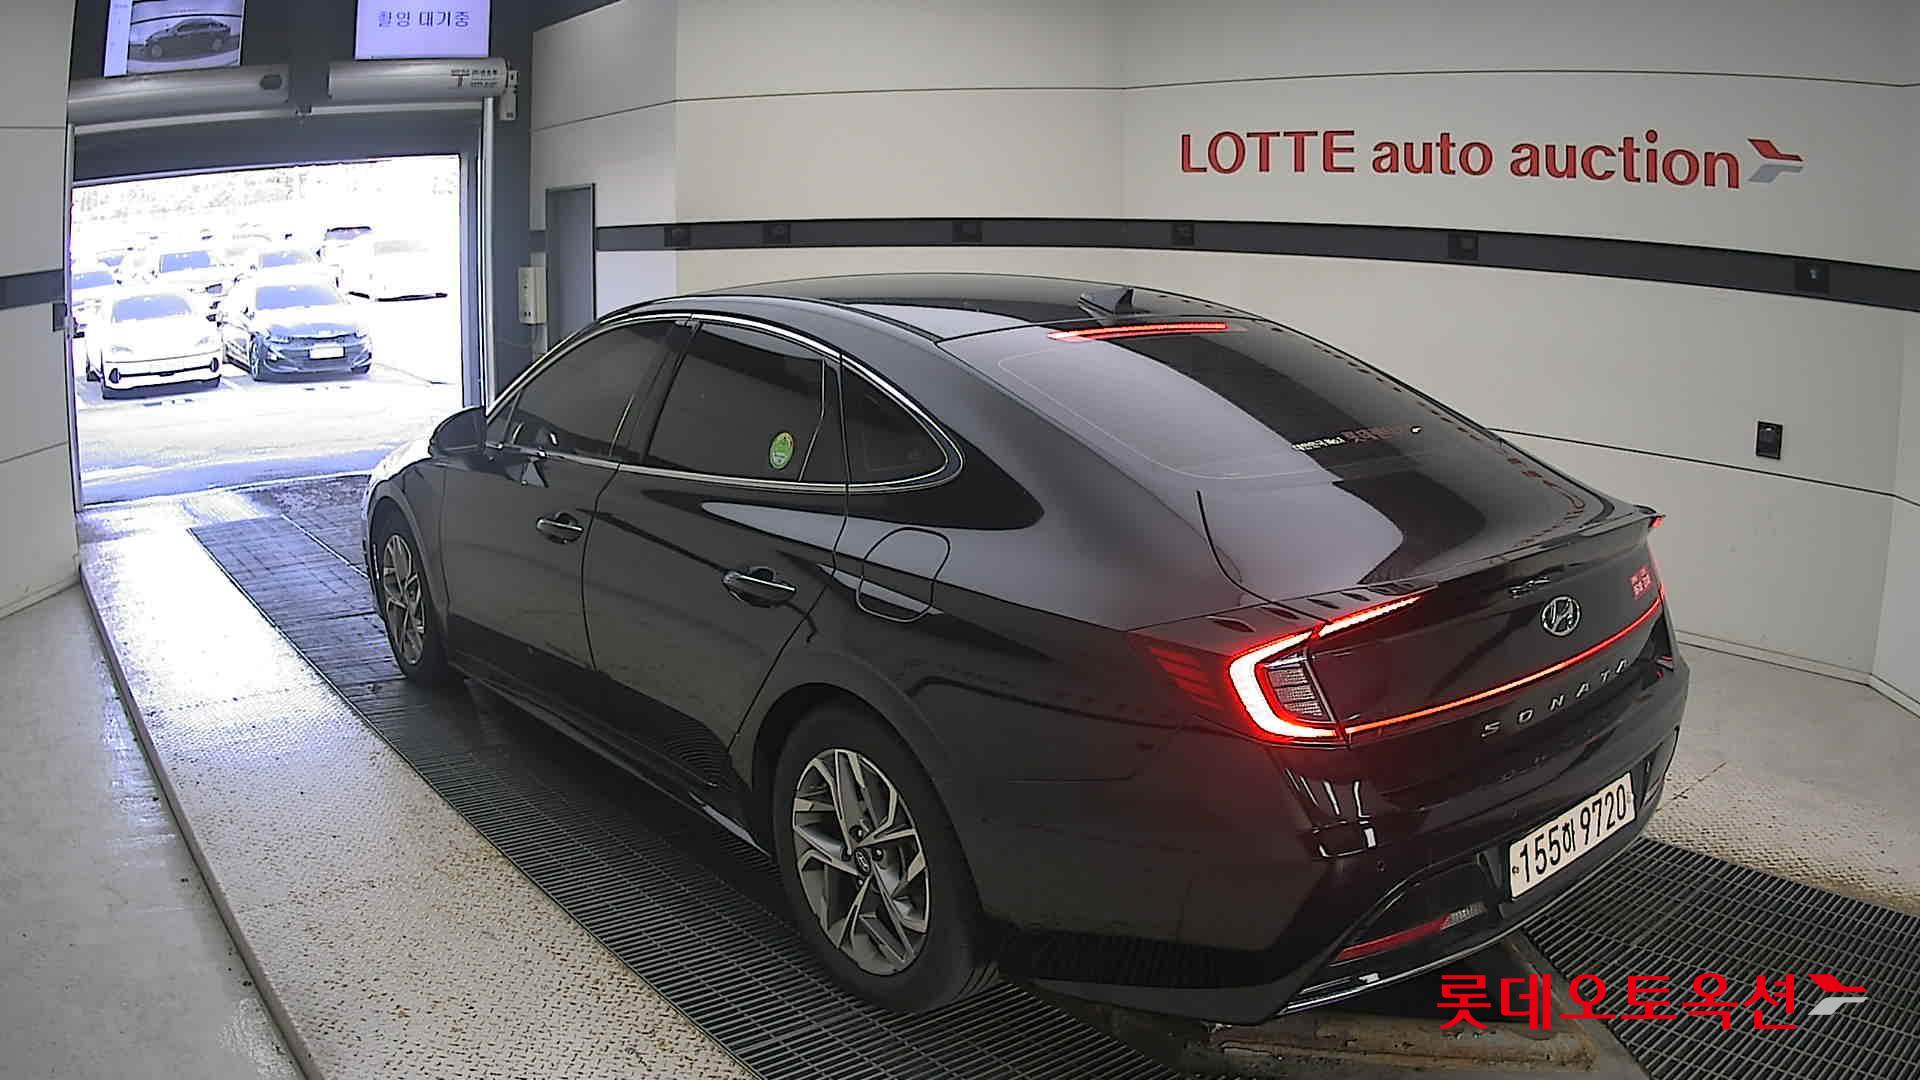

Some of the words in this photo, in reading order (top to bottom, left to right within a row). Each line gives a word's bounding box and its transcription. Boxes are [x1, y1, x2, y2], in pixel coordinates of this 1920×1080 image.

[419, 11, 470, 28] 대기중
[1181, 130, 1355, 174] LOTTE
[1372, 132, 1494, 176] auto
[1510, 130, 1741, 189] auction
[1481, 658, 1629, 739] SONATA
[1519, 818, 1576, 883] 155하
[1579, 784, 1626, 846] 9720
